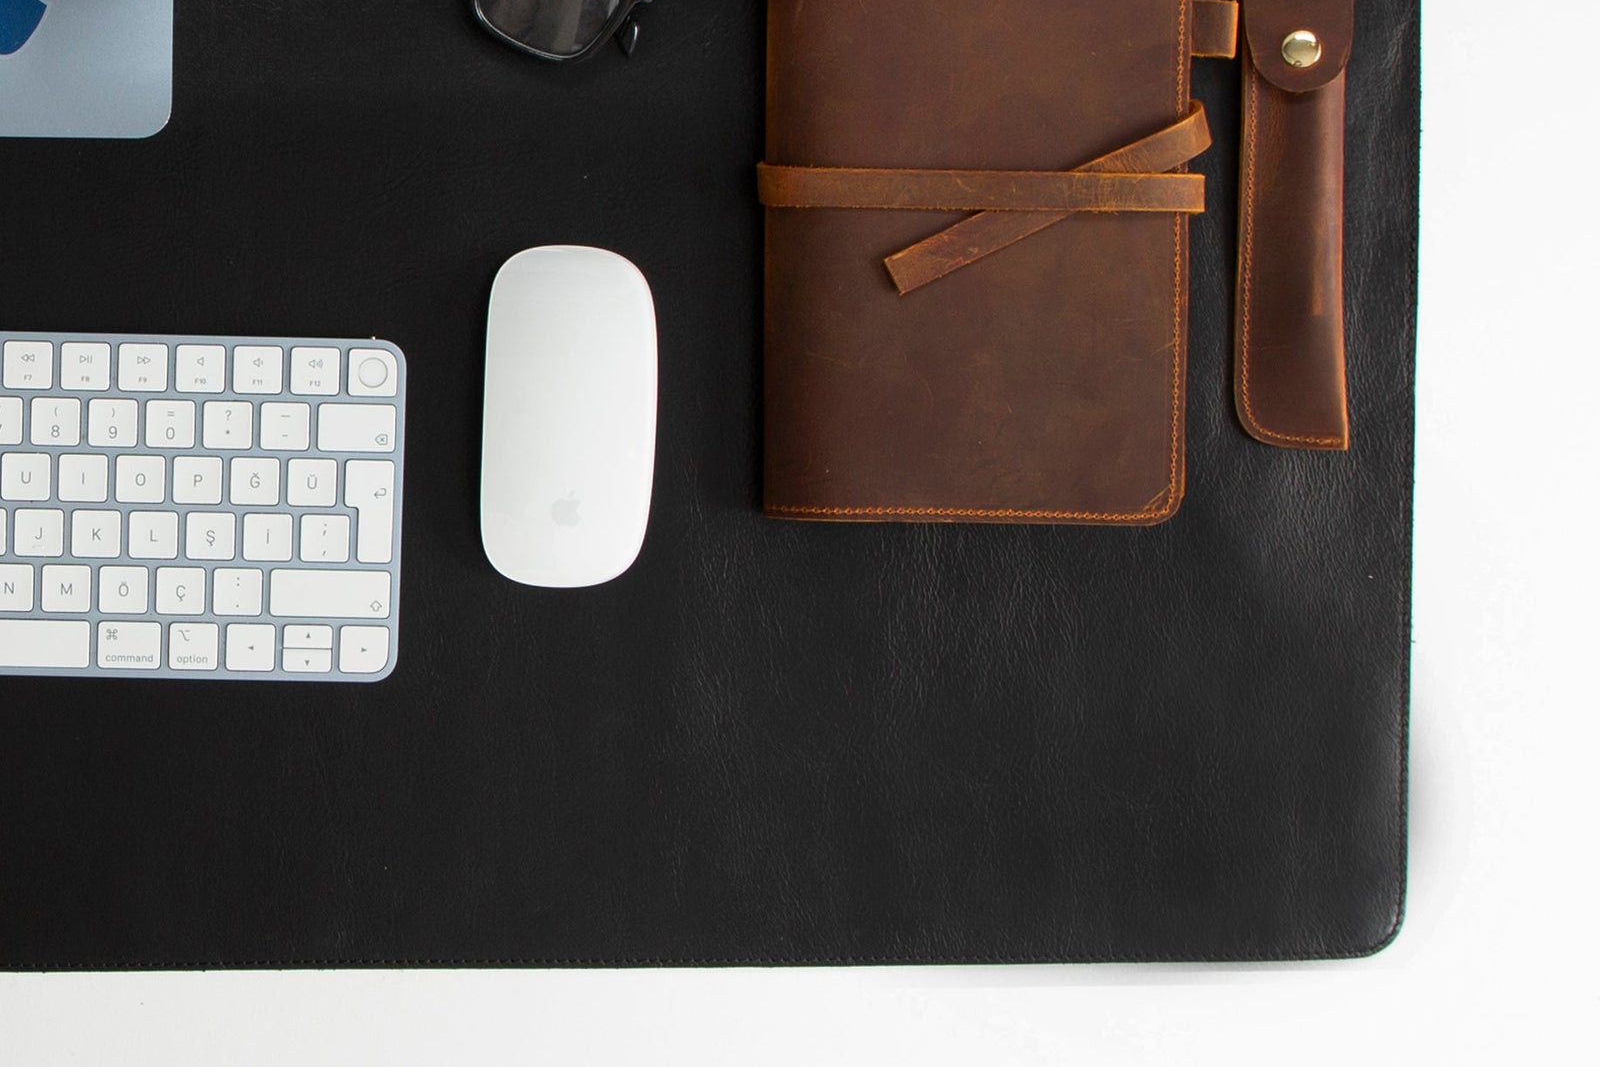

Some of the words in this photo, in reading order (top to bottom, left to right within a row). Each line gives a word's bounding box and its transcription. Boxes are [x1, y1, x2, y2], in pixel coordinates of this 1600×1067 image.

[23, 373, 33, 381] F7
[80, 375, 91, 383] F8
[138, 376, 148, 384] F9
[194, 377, 207, 385] F10
[251, 378, 263, 386] F11
[309, 380, 321, 388] F12
[50, 424, 61, 439] 8
[108, 425, 118, 440] 9
[165, 426, 176, 440] 0
[20, 470, 32, 485] U
[135, 472, 147, 487] O
[193, 473, 204, 487] P
[249, 472, 261, 489] Ğ
[306, 473, 318, 490] Ü
[34, 526, 43, 541] J
[91, 527, 102, 541] K
[149, 529, 158, 543] L
[206, 529, 216, 547] Ş
[3, 581, 15, 595] N
[60, 582, 73, 596] M
[118, 581, 130, 598] Ö
[175, 584, 186, 602] Ç
[105, 654, 154, 663] command
[176, 655, 208, 664] option
